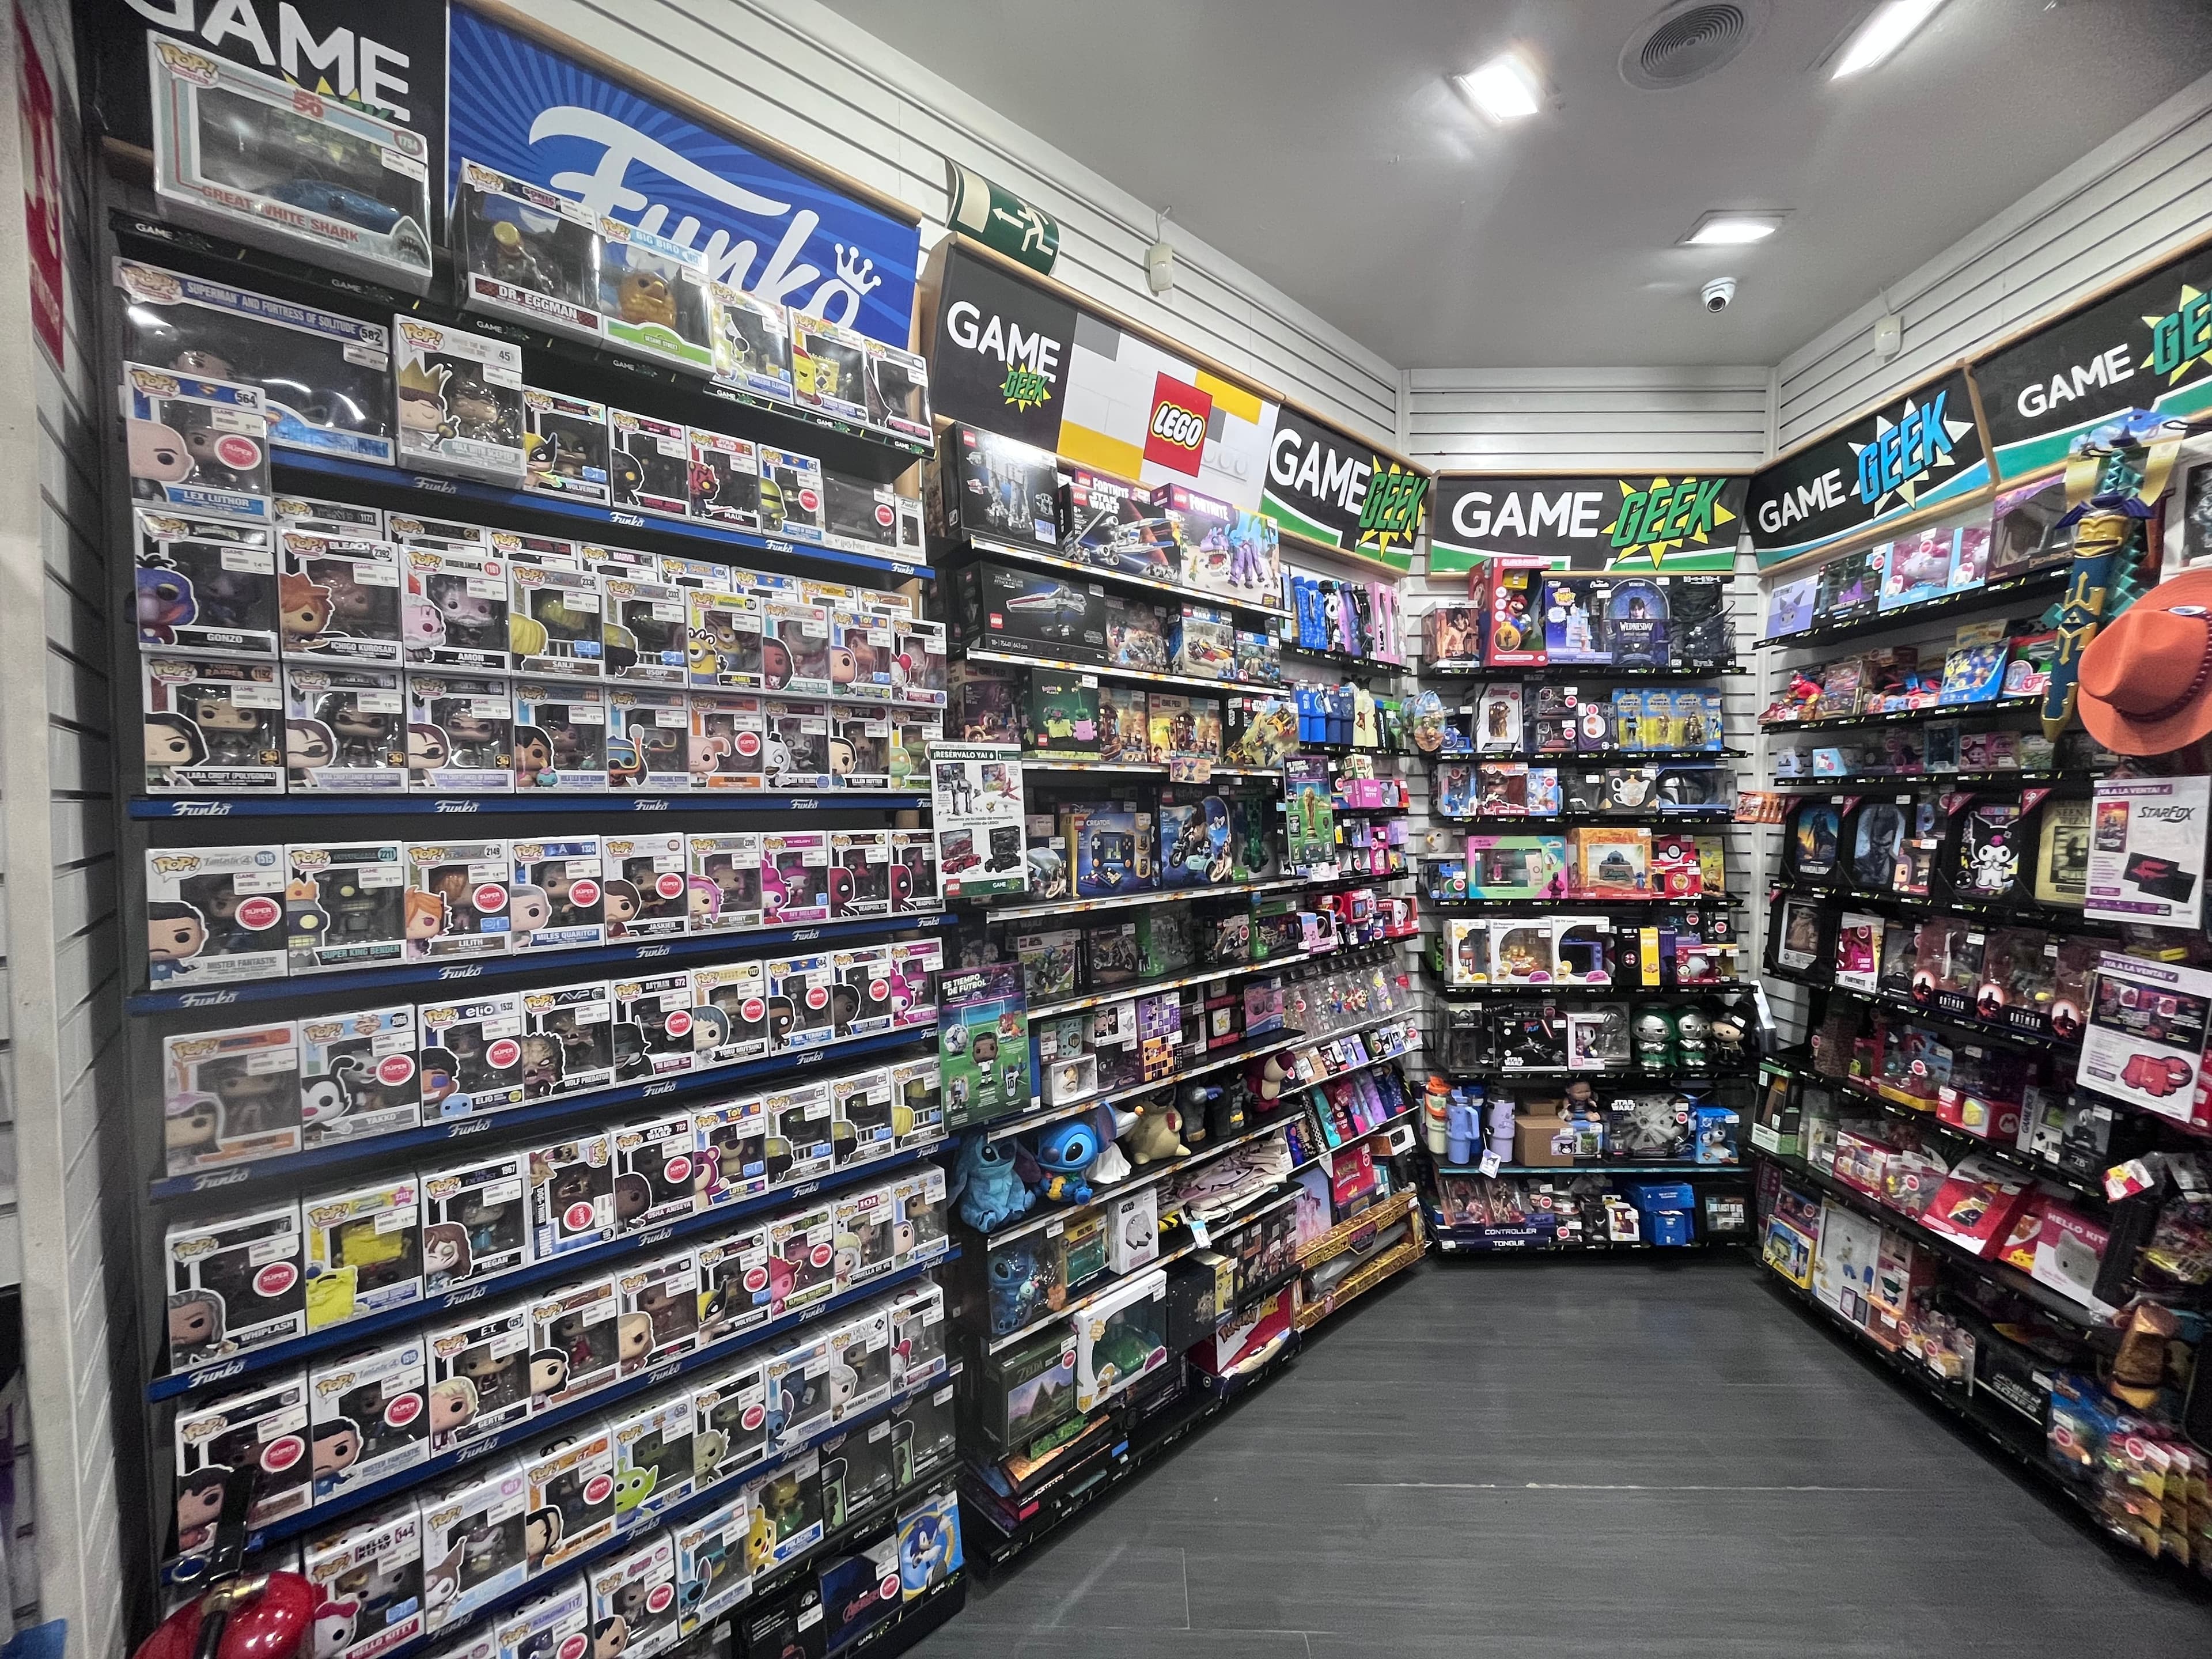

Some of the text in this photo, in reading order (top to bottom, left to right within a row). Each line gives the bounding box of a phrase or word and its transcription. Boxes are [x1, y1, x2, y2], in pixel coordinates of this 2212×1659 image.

[202, 185, 359, 243] GREAT WHITE SHARK
[529, 106, 861, 329] Funko
[135, 222, 173, 238] GAME
[635, 231, 680, 254] BIG BIRD
[331, 278, 361, 293] GAME
[187, 282, 355, 335] SUPERMAN AND FORTRESS OF SOLITUDE
[498, 285, 578, 320] DR. EGGMAN
[476, 320, 502, 334] GAME
[361, 327, 381, 342] 582
[645, 335, 679, 351] SESAME STREET
[946, 300, 1061, 384] GAME
[498, 350, 510, 361] 45
[2017, 287, 2212, 419] GAME GE
[613, 359, 635, 371] GAME
[1003, 370, 1049, 401] GEEK
[237, 392, 255, 405] 564
[717, 390, 736, 400] GAME
[816, 418, 834, 427] GAME
[1153, 401, 1205, 449] LEGO
[894, 441, 909, 449] GAME
[1758, 390, 1954, 534] GAME GEEK
[414, 477, 457, 494] Funko
[1269, 427, 1430, 532] GAME GEEK
[566, 482, 601, 495] WOLVERINE
[1093, 478, 1130, 499] FORTNITE
[184, 490, 249, 507] LEX LUTHOR
[1090, 491, 1118, 505] STAR
[1089, 500, 1119, 514] WARS
[1175, 493, 1229, 520] LEGO FORTNITE
[1450, 478, 1729, 548] GAME GEEK
[610, 512, 645, 527] Funko
[724, 513, 744, 521] MAUL
[284, 535, 325, 553] POP!
[329, 541, 370, 551] BLEACH
[765, 540, 793, 553] Funko
[374, 548, 390, 559] 2392
[408, 552, 442, 569] POP!
[513, 567, 544, 583] POP!
[891, 562, 915, 575] Funko
[859, 616, 873, 624] TOY
[1620, 622, 1653, 632] WEDNESDAY
[207, 633, 243, 643] GONZO
[331, 642, 396, 654] ICHIGO KUROSAKI
[457, 653, 484, 662] AMON
[552, 661, 574, 669] SANJI
[204, 669, 244, 679] RAIDER
[934, 751, 988, 759] ¡RESÉRVALO YA!
[172, 801, 233, 817] Funko
[434, 800, 480, 813] Funko
[634, 800, 669, 810] Funko
[790, 798, 819, 809] Funko
[379, 849, 395, 861] 2211
[486, 846, 501, 856] 2149
[581, 844, 595, 854] 1324
[151, 855, 200, 873] POP!
[256, 853, 274, 864] 1515
[290, 850, 328, 866] POP!
[575, 888, 594, 896] SÚPER
[946, 882, 960, 891] LEGO
[479, 892, 501, 900] SÚPER
[244, 906, 272, 916] SÚPER
[648, 922, 676, 931] JASKIER
[536, 929, 597, 941] MILES QUARITCH
[791, 930, 820, 941] Funko
[459, 939, 483, 948] LILITH
[321, 945, 400, 960] SUPER KING BENDER
[636, 945, 671, 959] Funko
[207, 957, 277, 969] MISTER FANTASTIC
[438, 965, 483, 980] Funko
[675, 978, 685, 987] 572
[942, 974, 980, 990] ES TIEMPO
[557, 990, 590, 1002] AVP
[947, 987, 958, 996] DE
[180, 991, 238, 1007] Funko
[500, 1002, 513, 1011] 1532
[805, 1031, 828, 1040] TERRIFIC
[719, 1044, 762, 1056] TORU MUTSUKI
[565, 1073, 610, 1088] WOLF PREDATOR
[642, 1082, 677, 1097] Funko
[475, 1096, 494, 1105] ELIO
[365, 1113, 396, 1124] YAKKO
[726, 1107, 743, 1117] TOY
[676, 1123, 687, 1132] 722
[501, 1165, 516, 1176] 1967
[729, 1185, 748, 1194] LOTSO
[647, 1202, 691, 1219] OSHA ANISEYA
[2047, 1212, 2084, 1233] HELLO
[1484, 1228, 1537, 1236] CONTROLLER
[482, 1256, 508, 1269] REGAN
[853, 1267, 874, 1279] CRUELLA
[734, 1312, 764, 1327] WOLVERINE
[241, 1320, 294, 1342] WHIPLASH
[478, 1413, 506, 1429] GERTIE
[854, 1526, 870, 1539] GAME
[785, 1530, 813, 1551] PIKACHU
[758, 1582, 777, 1596] GAME
[931, 1582, 945, 1594] GAME
[858, 1633, 873, 1646] GAME
